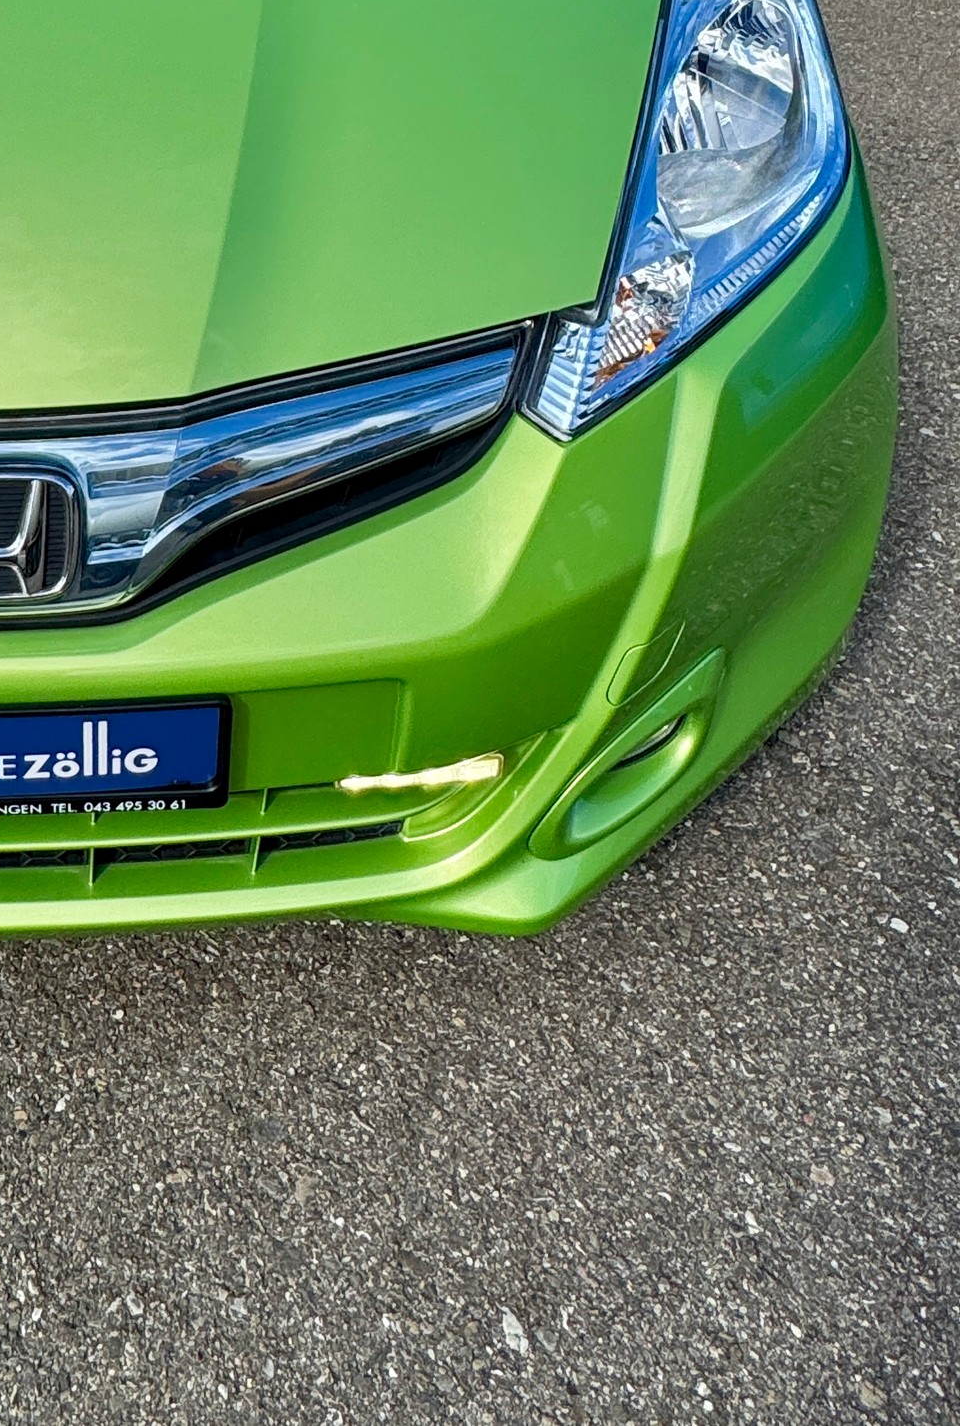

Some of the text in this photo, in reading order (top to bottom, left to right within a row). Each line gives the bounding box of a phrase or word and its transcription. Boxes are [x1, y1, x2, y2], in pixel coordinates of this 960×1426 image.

[51, 803, 77, 813] TEL.
[83, 802, 111, 813] 043
[115, 801, 142, 811] 495
[147, 800, 166, 811] 30
[170, 799, 186, 810] 61
